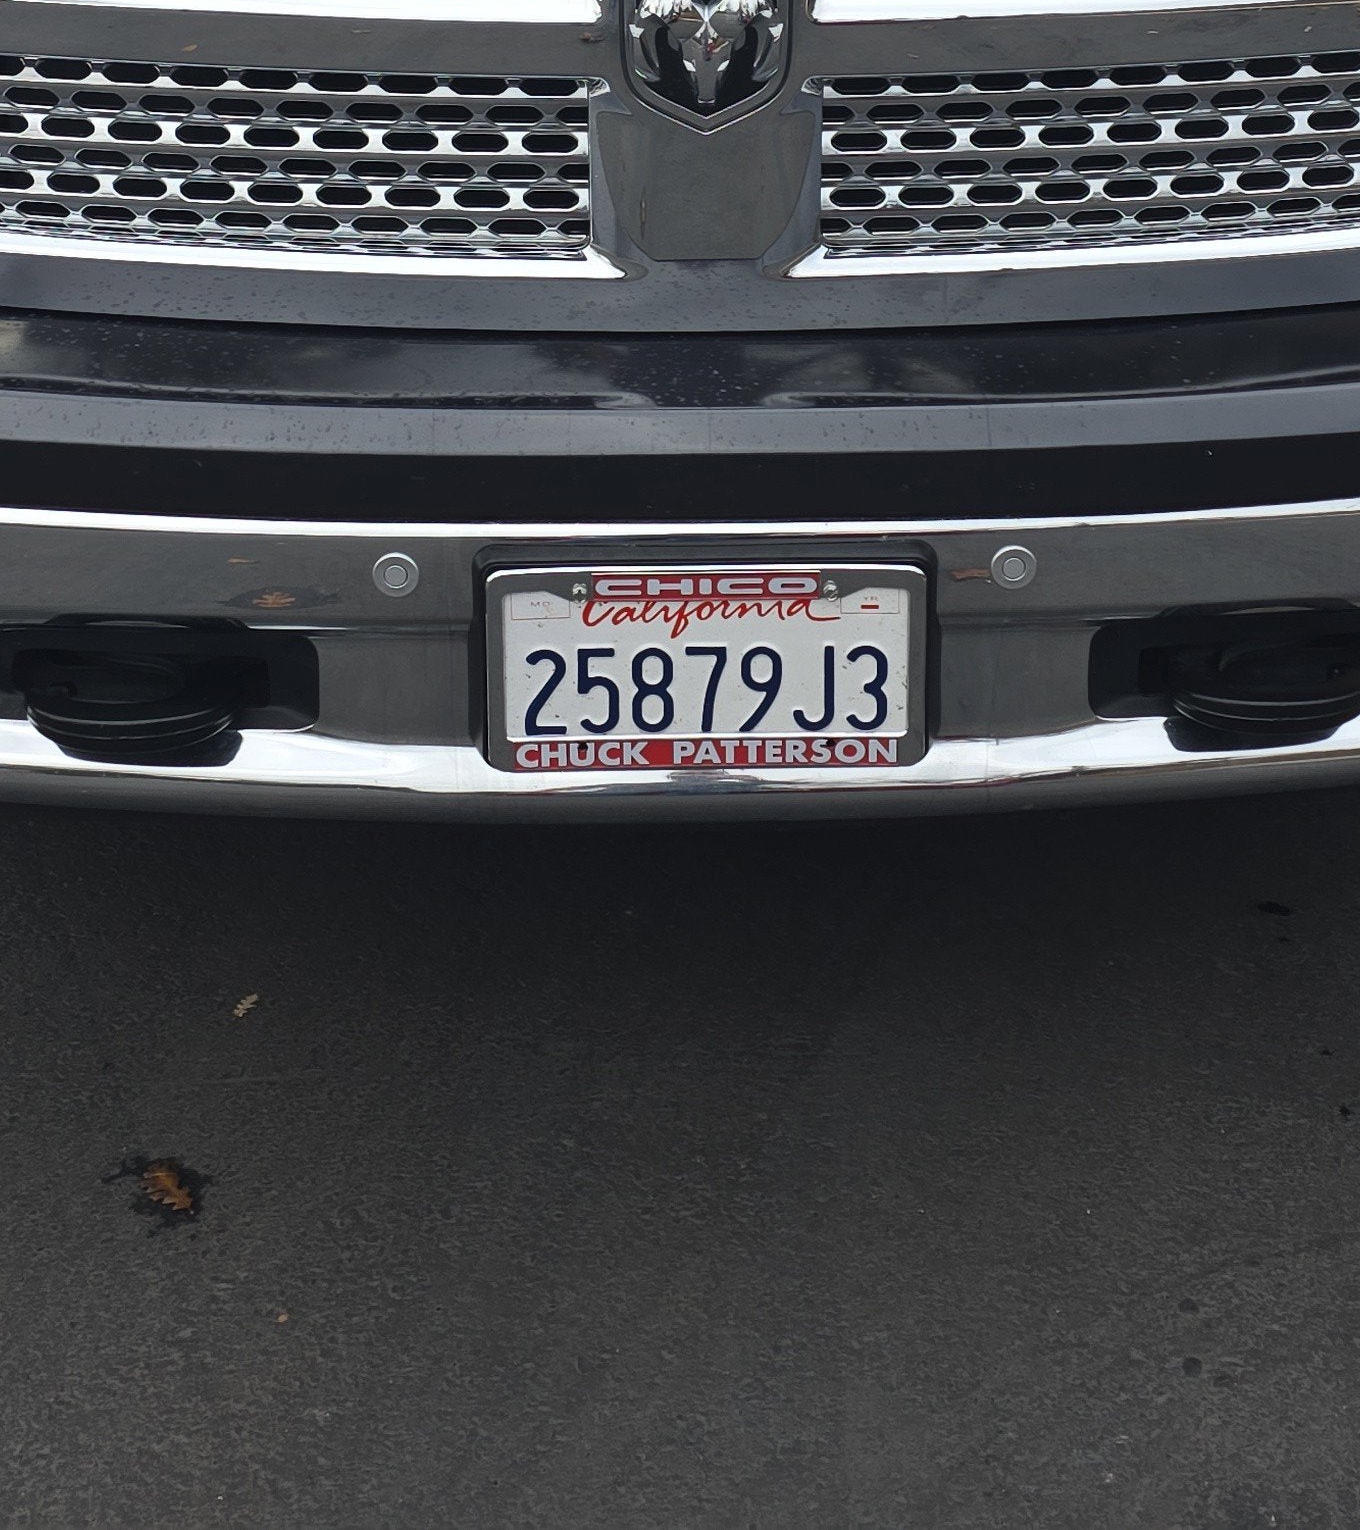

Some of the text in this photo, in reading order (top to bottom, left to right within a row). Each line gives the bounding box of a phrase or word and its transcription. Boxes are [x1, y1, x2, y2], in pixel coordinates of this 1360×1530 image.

[595, 577, 818, 595] CHICO
[582, 600, 840, 638] California
[525, 646, 888, 735] 25879J3
[517, 739, 897, 767] CHUCK PATTERSON
